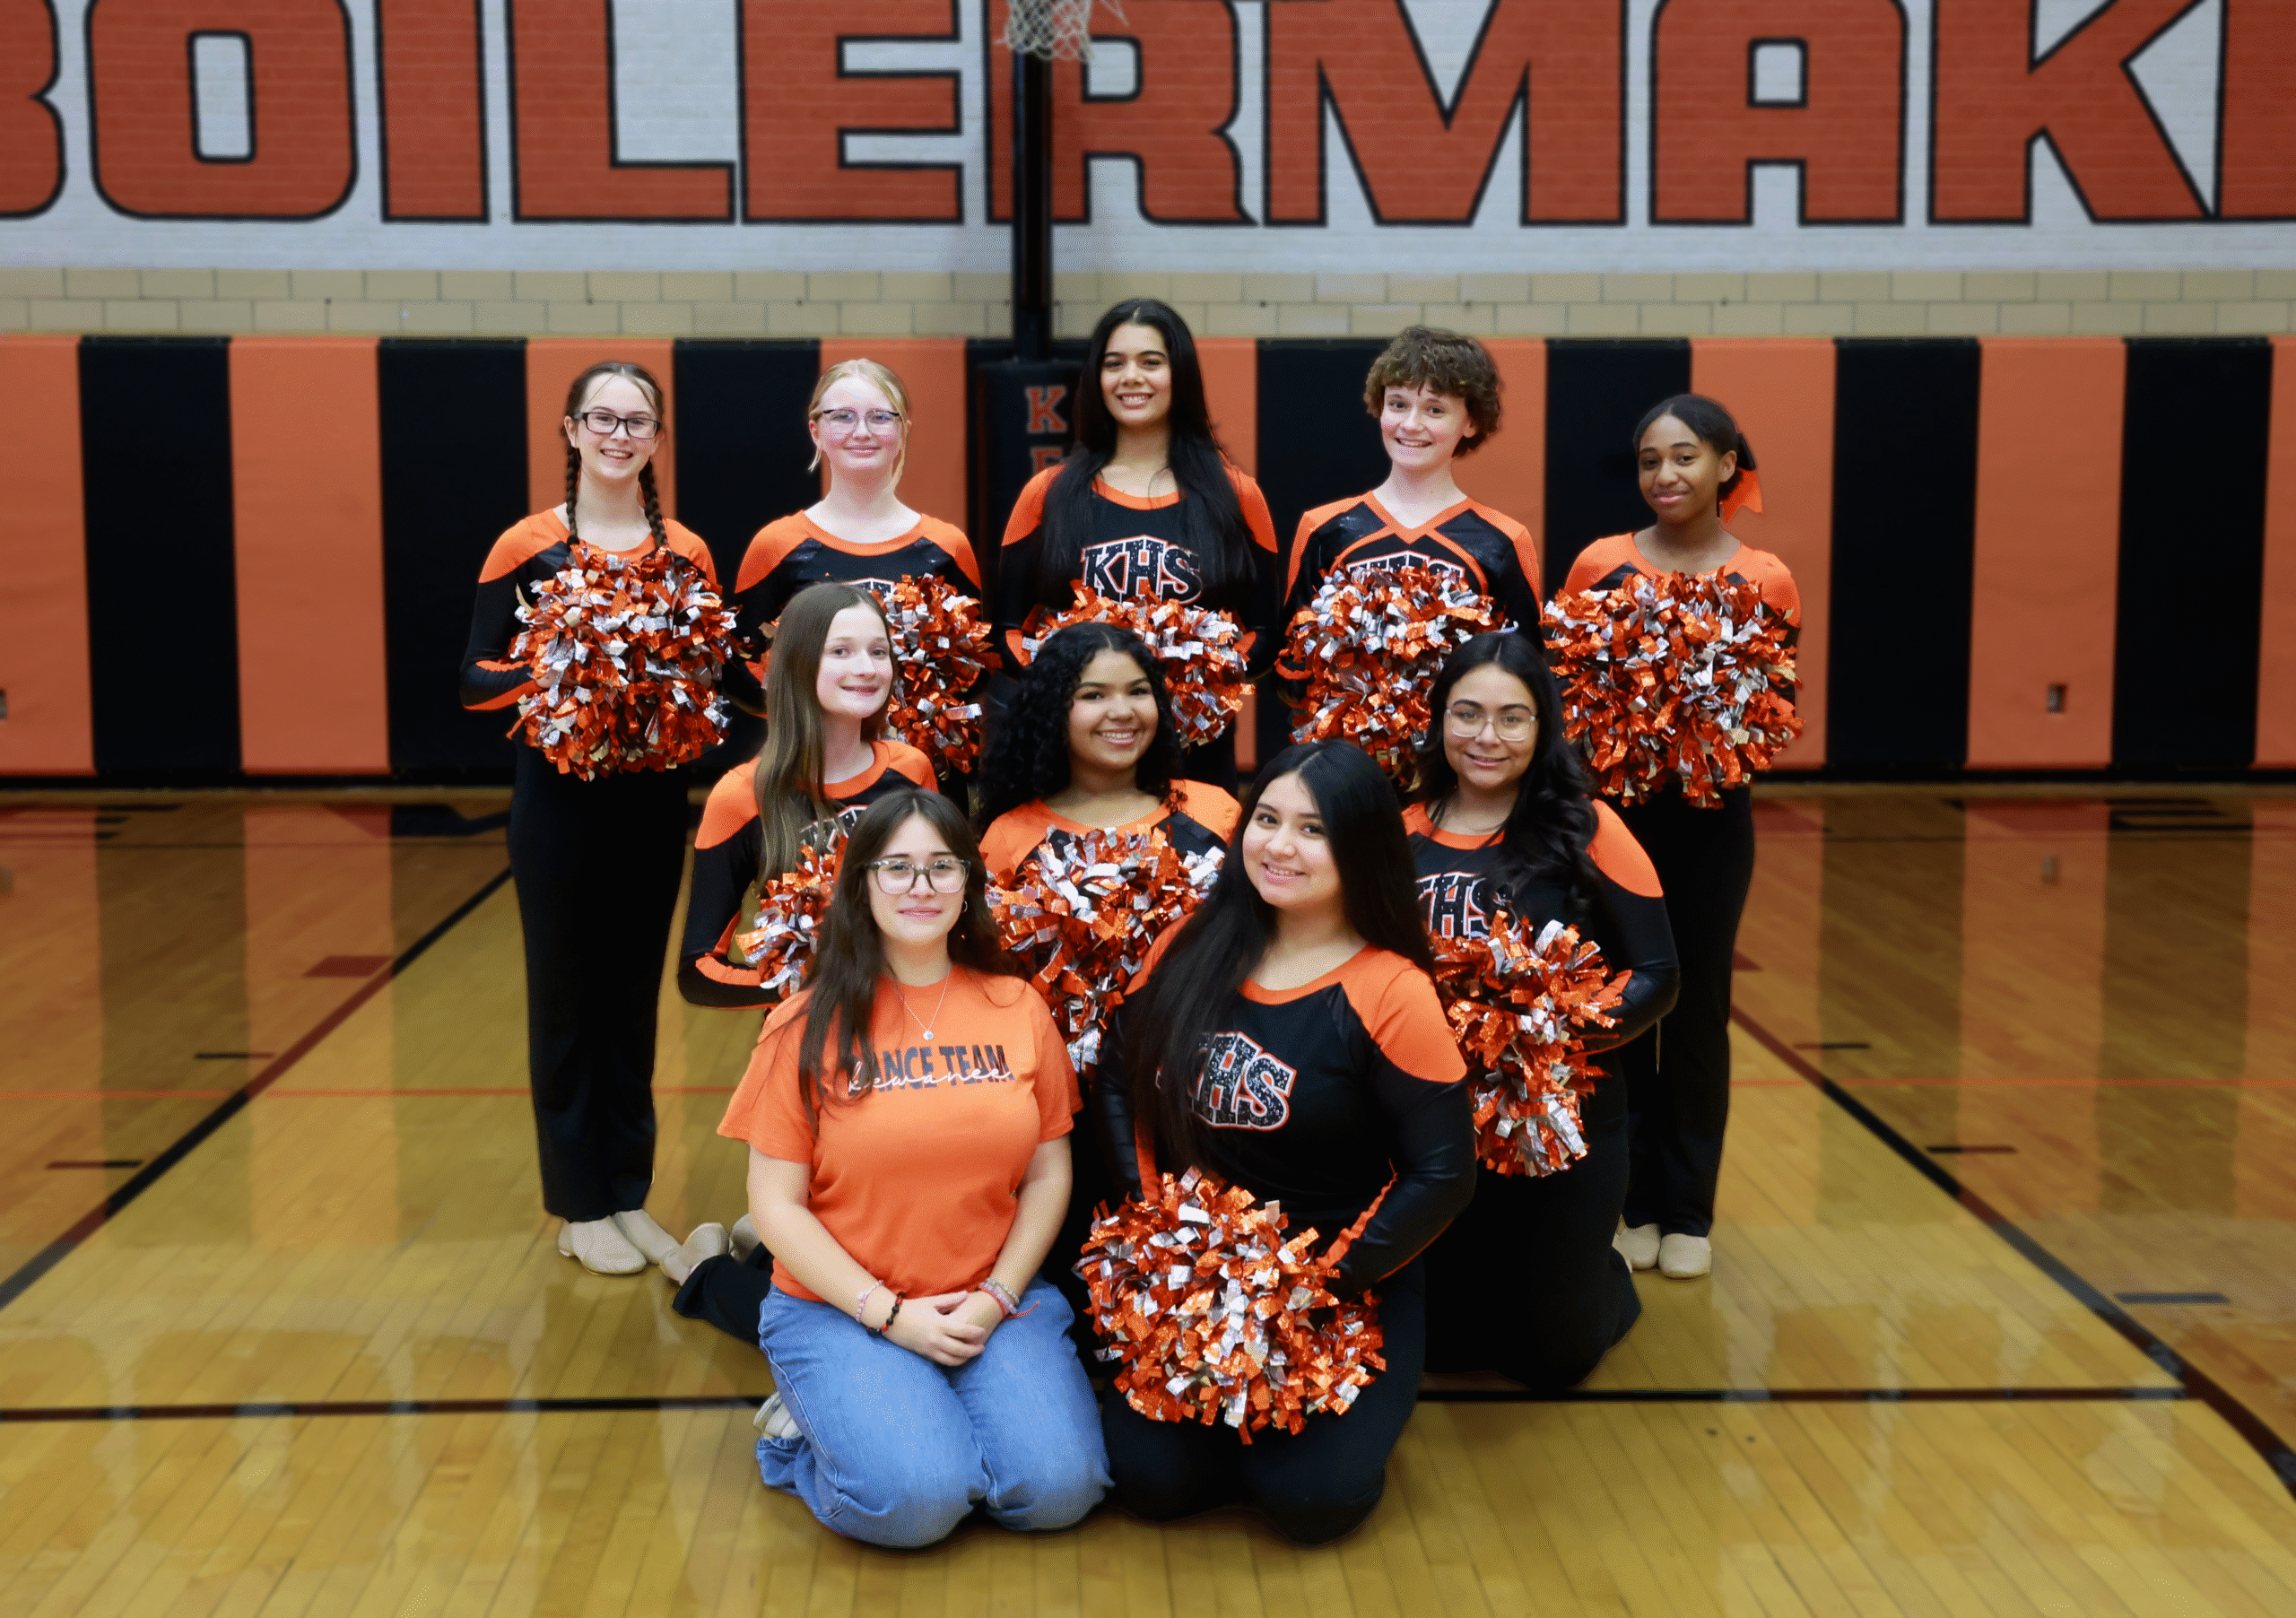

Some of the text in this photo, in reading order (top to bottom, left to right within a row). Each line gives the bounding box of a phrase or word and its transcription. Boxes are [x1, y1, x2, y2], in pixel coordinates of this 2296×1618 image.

[0, 0, 2296, 225] OILERMAK
[1080, 535, 1203, 605] KHS
[1410, 871, 1520, 942] HS
[939, 1045, 1015, 1086] TEAM
[1156, 1031, 1297, 1132] HS
